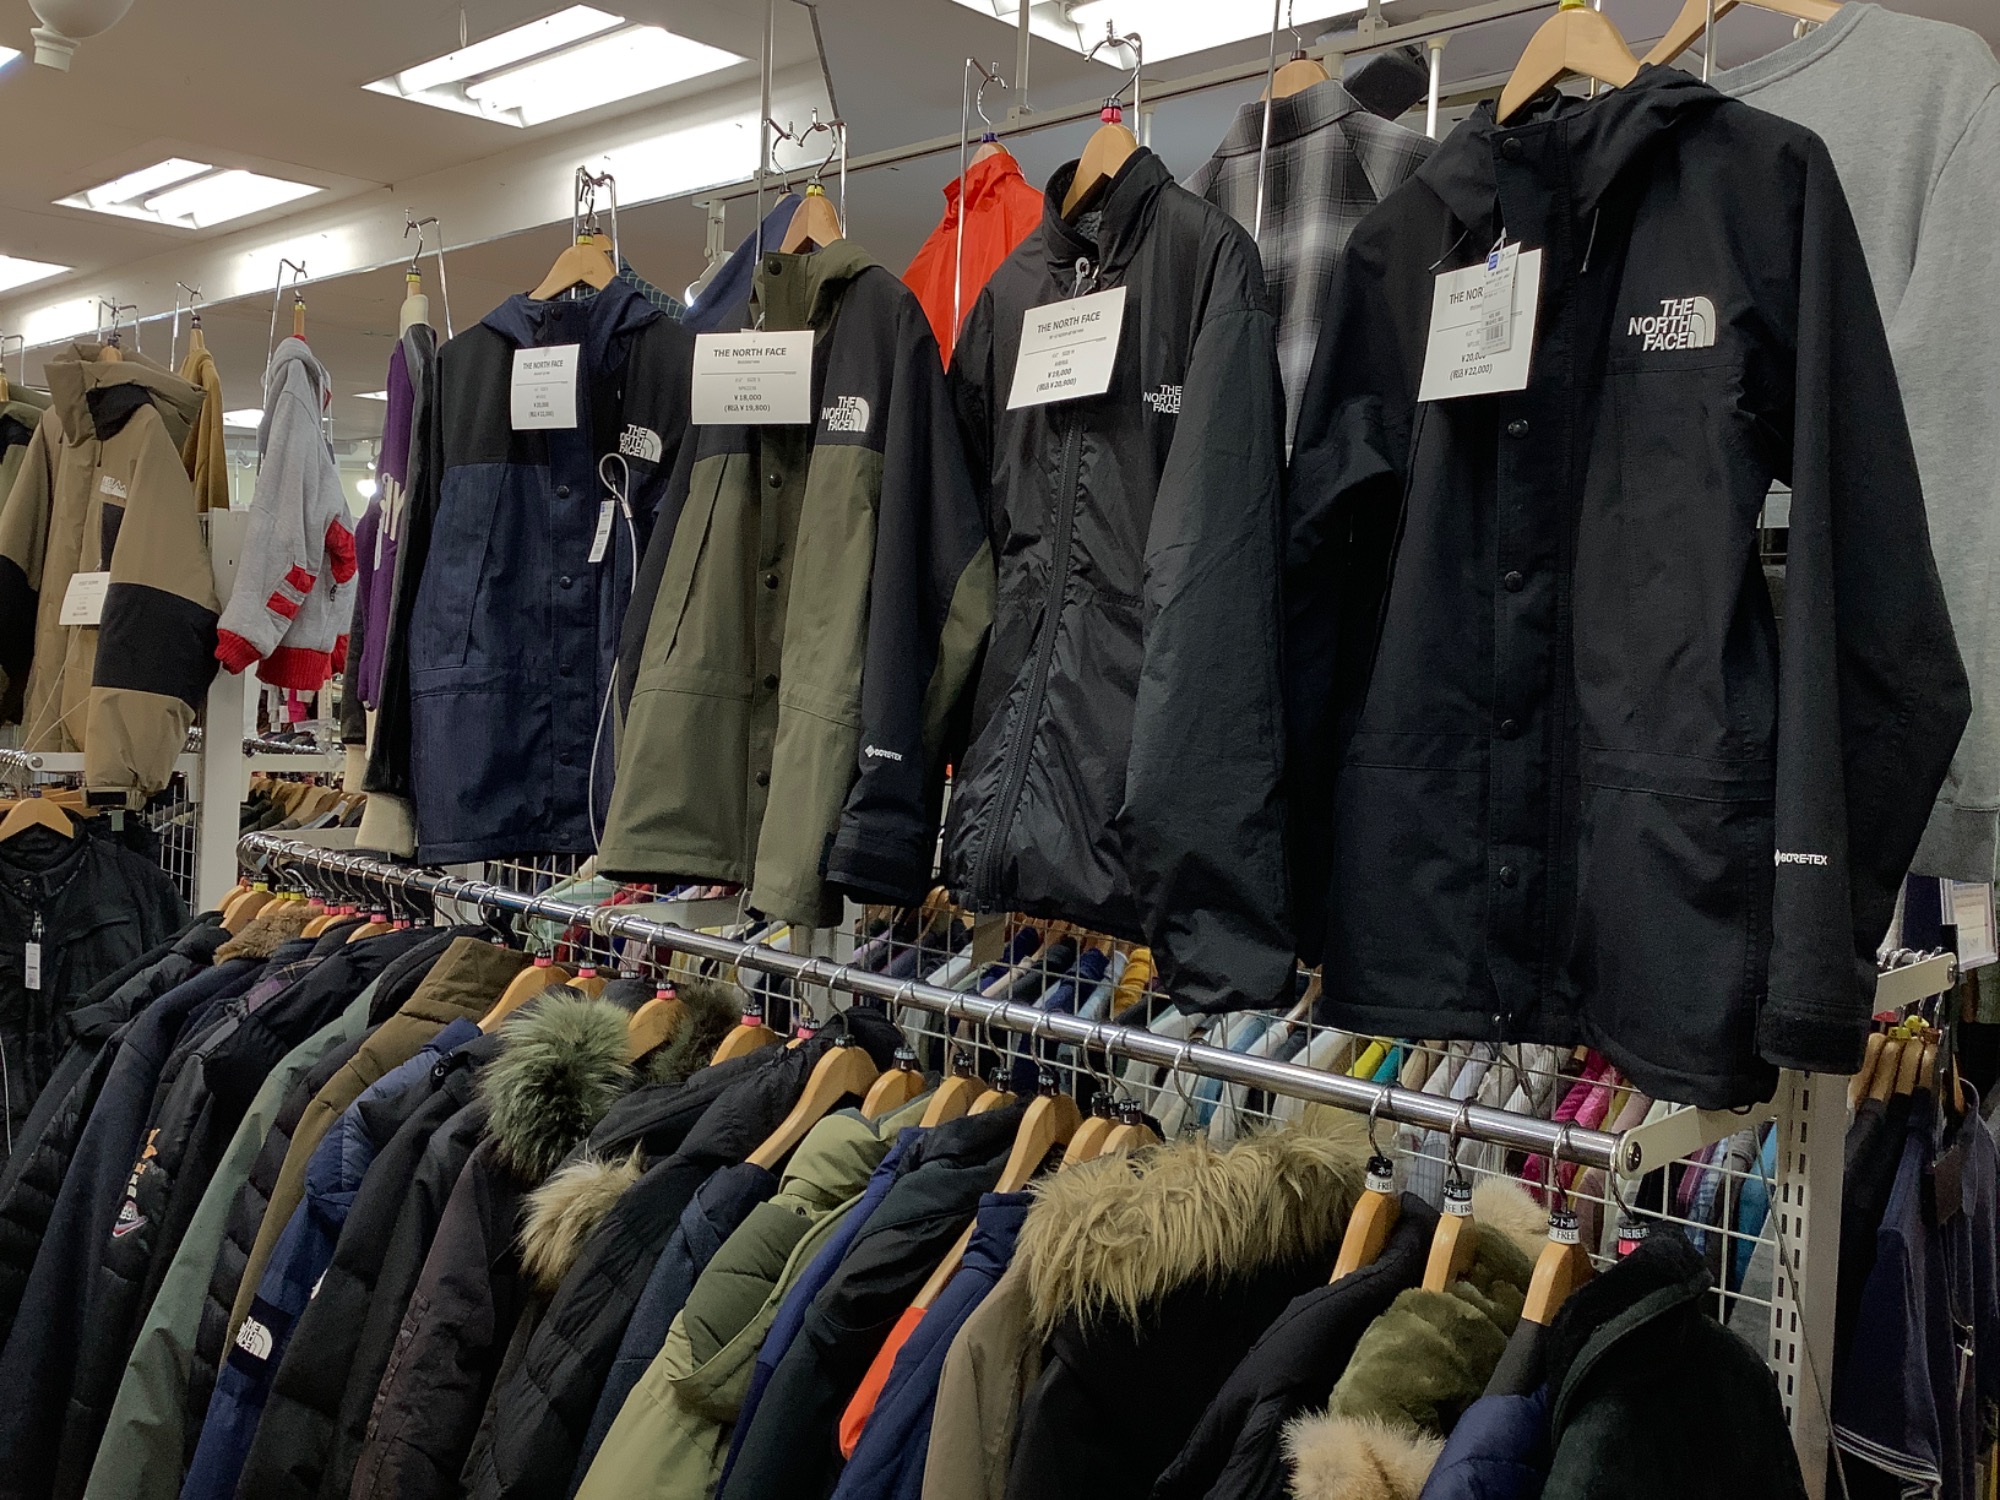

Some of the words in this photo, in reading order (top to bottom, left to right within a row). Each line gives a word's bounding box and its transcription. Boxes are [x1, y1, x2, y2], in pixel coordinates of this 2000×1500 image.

[1449, 291, 1465, 305] THE
[1466, 286, 1484, 301] NOR
[1660, 297, 1695, 317] THE
[1037, 324, 1052, 334] THE
[1053, 316, 1081, 330] NORTH
[1081, 311, 1101, 324] FACE
[1627, 314, 1691, 336] NORTH
[1642, 331, 1689, 352] FACE
[713, 348, 731, 358] THE
[732, 347, 763, 357] NORTH
[765, 347, 787, 356] FACE
[523, 362, 532, 370] THE
[533, 361, 551, 369] NORTH
[551, 359, 563, 367] FACE
[1160, 384, 1183, 396] THE
[837, 395, 857, 409] THE
[1143, 391, 1181, 404] NORTH
[821, 407, 854, 420] NORTH
[1153, 402, 1180, 414] FACE
[627, 423, 648, 440] THE
[827, 418, 851, 431] FACE
[619, 432, 643, 449] ORTH
[1781, 852, 1828, 866] GORE-TEX
[1556, 1230, 1577, 1241] FREE
